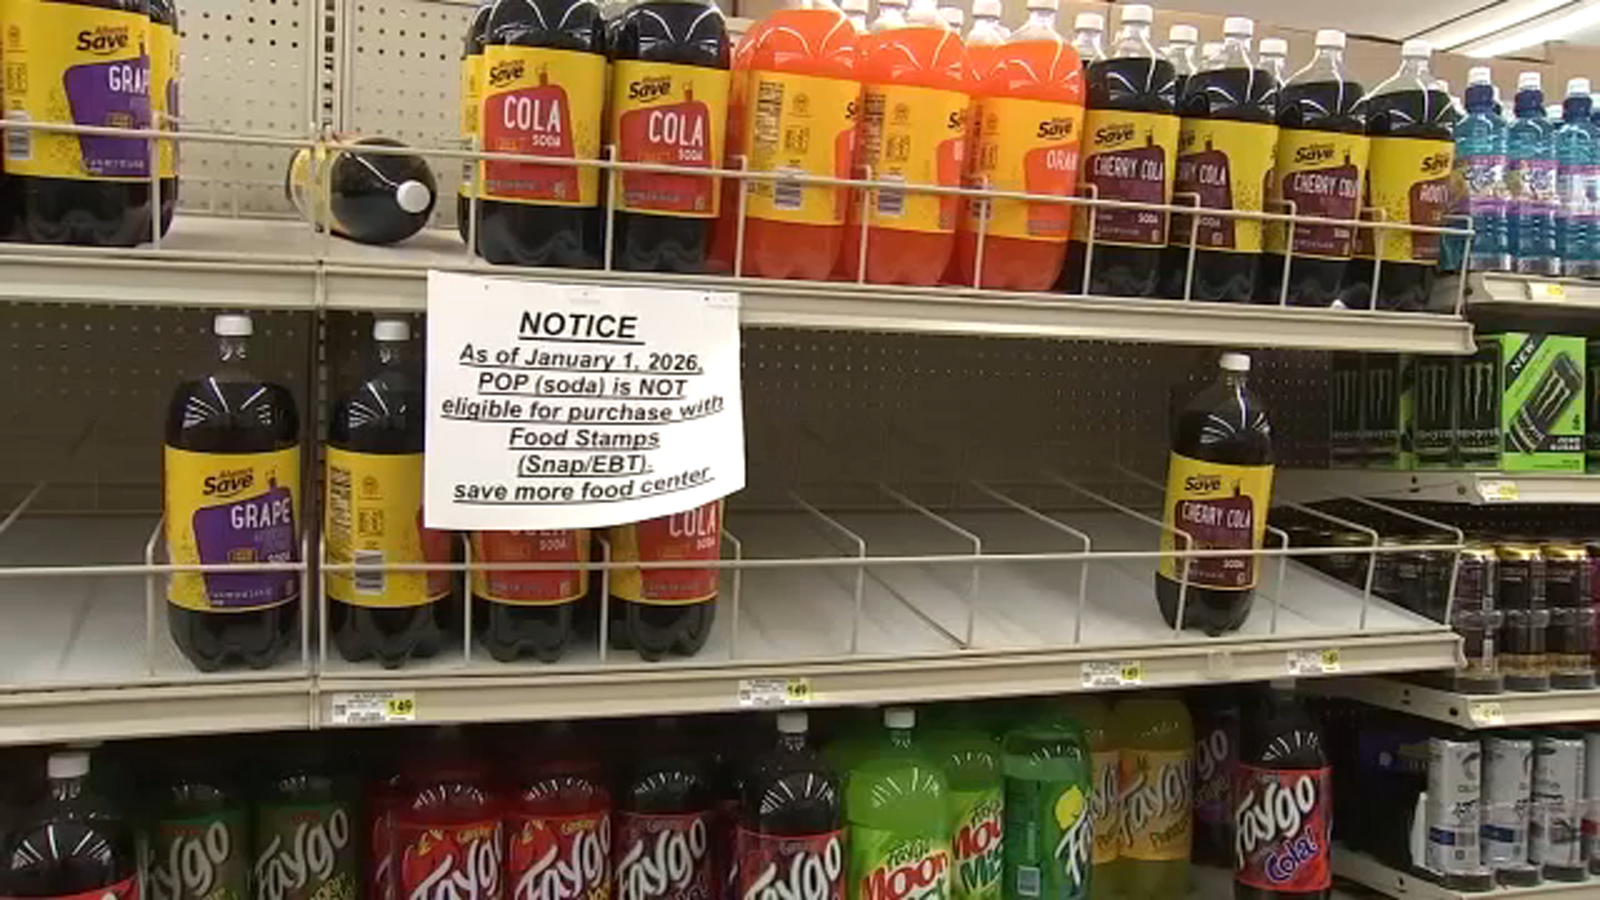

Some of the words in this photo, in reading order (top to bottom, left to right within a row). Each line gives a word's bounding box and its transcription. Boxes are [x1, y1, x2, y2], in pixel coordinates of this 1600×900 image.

[76, 30, 129, 51] Save
[108, 64, 150, 94] GRAP
[489, 65, 525, 85] Save
[628, 81, 671, 99] Save
[504, 94, 561, 133] COLA
[532, 133, 561, 147] SODA
[649, 109, 704, 147] COLA
[1037, 121, 1074, 138] Save
[1094, 127, 1135, 145] Save
[679, 147, 704, 161] SODA
[1094, 155, 1138, 178] CHERRY
[1294, 146, 1335, 163] Save
[1200, 164, 1227, 186] COLA
[1294, 174, 1336, 197] CHERRY
[1137, 212, 1159, 224] SODA
[1199, 216, 1221, 227] ODA
[518, 311, 638, 339] NOTICE
[459, 343, 489, 364] As
[495, 346, 521, 365] of
[525, 349, 616, 373] January
[624, 352, 640, 372] 1,
[1511, 339, 1536, 374] NEW
[478, 371, 529, 392] POP
[534, 375, 606, 398] (soda)
[613, 376, 632, 396] is
[639, 379, 688, 397] NOT
[441, 397, 523, 421] eligible
[529, 401, 562, 420] for
[567, 403, 674, 425] purchase
[679, 394, 725, 417] with
[509, 427, 568, 446] Food
[574, 429, 660, 451] Stamps
[203, 474, 254, 496] Save
[453, 484, 508, 501] save
[514, 486, 574, 501] more
[581, 480, 634, 499] food
[640, 466, 710, 494] center
[1184, 477, 1221, 491] Save
[231, 498, 291, 530] GRAPE
[669, 504, 716, 539] COLA
[1182, 501, 1223, 527] CHERRY
[1227, 508, 1250, 529] COLA
[539, 538, 567, 551] SODA
[1235, 775, 1315, 871] Faygo
[254, 808, 349, 900] Faygo
[951, 820, 1001, 861] Moo
[154, 821, 230, 900] ygo
[514, 815, 612, 900] Faygo
[615, 817, 706, 900] Faygo
[1264, 826, 1319, 884] Cola!
[863, 851, 949, 900] Moon
